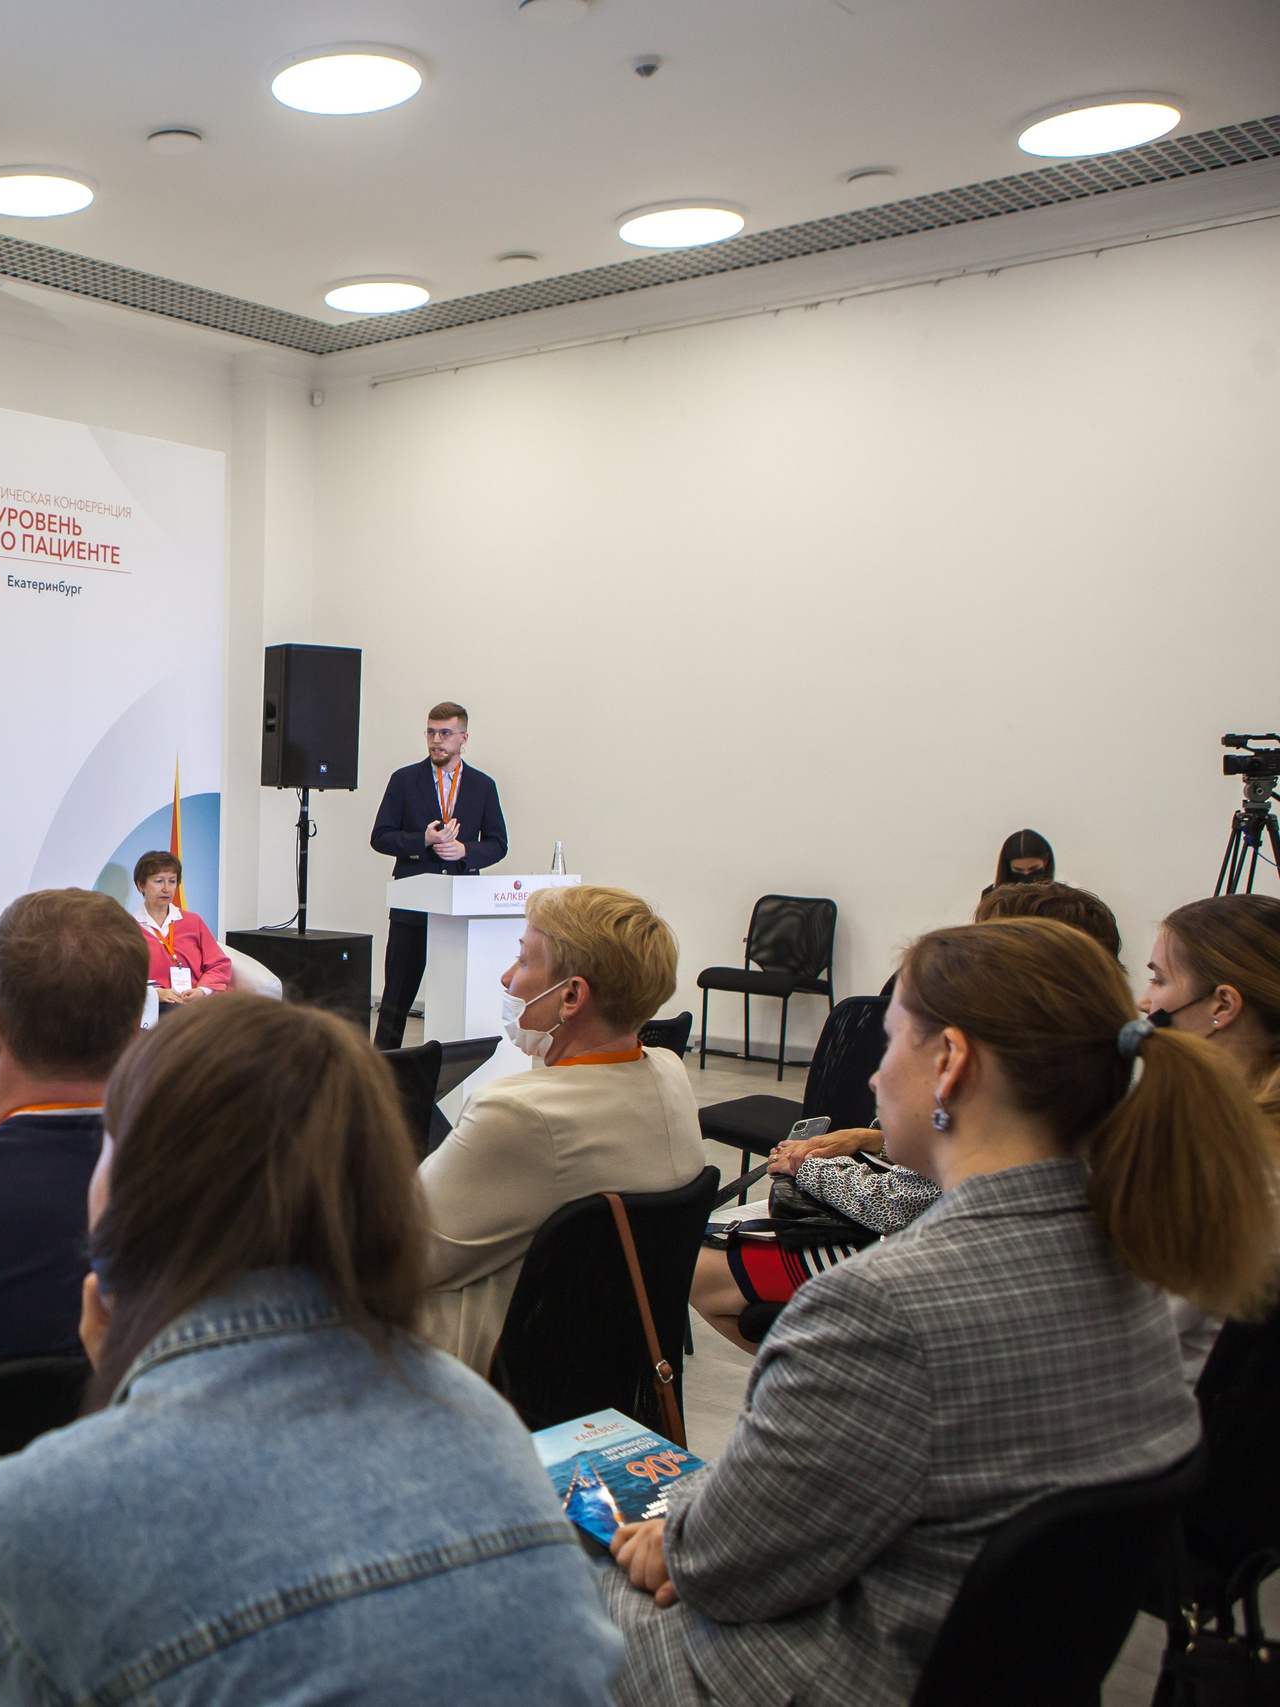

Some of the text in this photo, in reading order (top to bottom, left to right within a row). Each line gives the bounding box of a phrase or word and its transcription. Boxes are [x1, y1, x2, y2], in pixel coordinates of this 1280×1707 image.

[54, 496, 131, 518] КОНФЕРЕНЦИЯ
[1, 531, 15, 550] О
[23, 534, 120, 564] ПАЦИЕНТЕ
[8, 575, 82, 596] Екатеринбург
[494, 892, 530, 901] КАЛКВЕ
[626, 1450, 687, 1484] 90%
